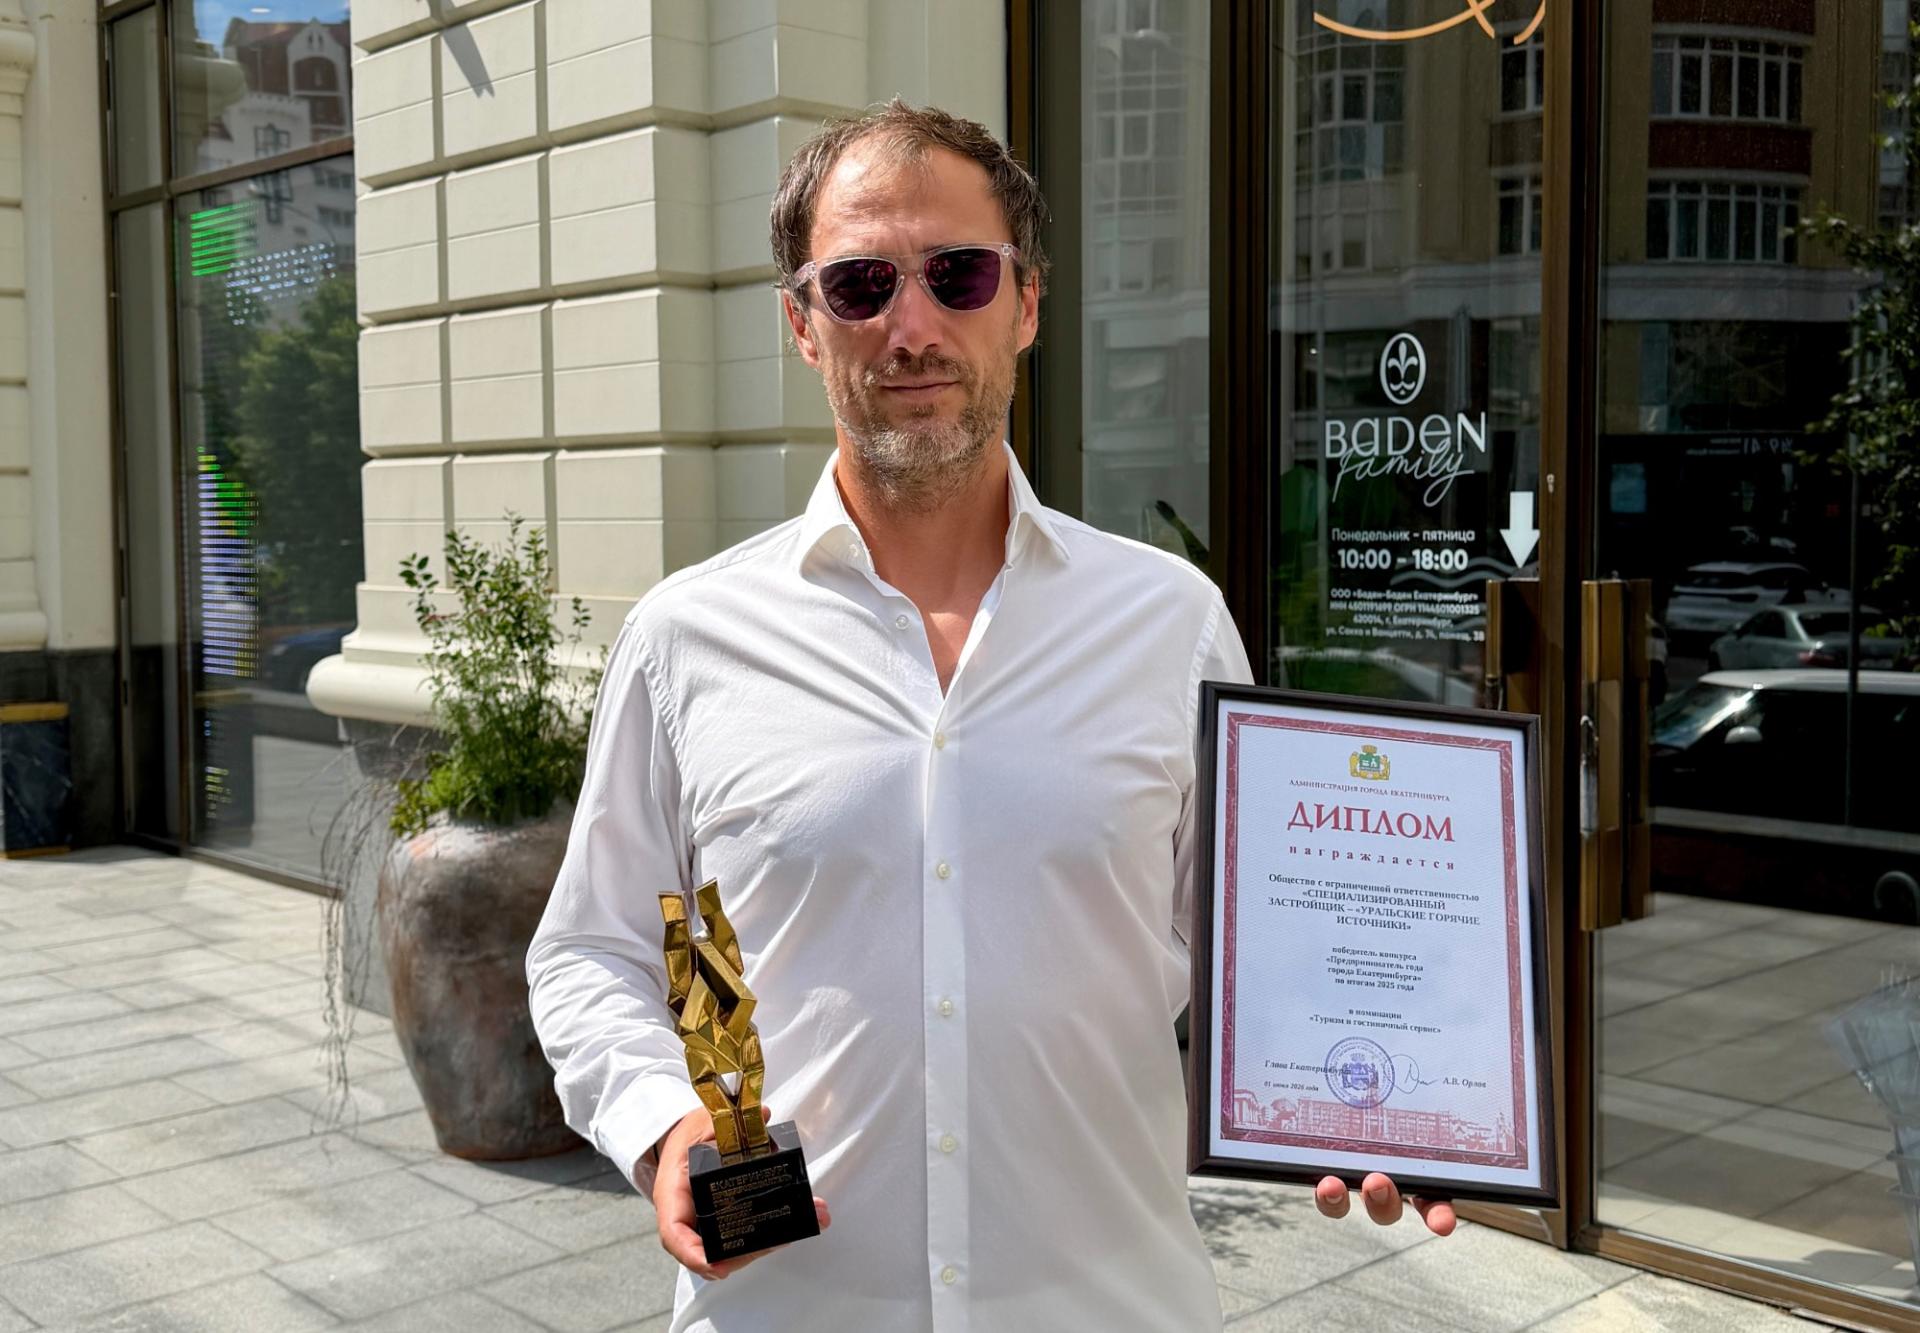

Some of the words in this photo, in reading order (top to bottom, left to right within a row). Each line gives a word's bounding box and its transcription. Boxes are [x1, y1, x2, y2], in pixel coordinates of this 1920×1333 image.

[1332, 528, 1410, 542] Понедельник
[1422, 529, 1475, 543] пятница
[1337, 549, 1391, 569] 10:00
[1412, 549, 1468, 570] 18:00
[1330, 588, 1351, 598] ООО
[1289, 779, 1358, 793] АДМИНИСТРАЦИЯ
[1360, 786, 1388, 796] ГОРОДА
[1390, 790, 1450, 802] ЕКАТЕРИНБУРГА
[1287, 800, 1455, 842] ДИПЛОМ
[1268, 873, 1315, 887] Общество
[1325, 880, 1391, 894] ограниченной
[1393, 888, 1479, 901] ответственностью
[1302, 889, 1445, 910] «СПЕЦИАЛИЗИРОВАННЫЙ
[1268, 897, 1345, 913] ЗАСТРОЙЩИК
[1355, 906, 1426, 921] «УРАЛЬСКИЕ
[1428, 912, 1480, 926] ГОРЯЧИЕ
[1336, 915, 1411, 931] ИСТОЧНИКИ»
[1332, 946, 1377, 958] победитель
[1379, 951, 1417, 962] конкурса
[1326, 955, 1403, 970] «Предприниматель
[1405, 963, 1423, 973] года
[1327, 967, 1354, 977] города
[1356, 968, 1422, 983] Екатеринбурга»
[1346, 979, 1375, 988] итогам
[1377, 980, 1395, 989] 2025
[1396, 983, 1414, 992] года
[1355, 1009, 1402, 1020] номинации
[1309, 1013, 1344, 1026] «Туризм
[1353, 1019, 1407, 1031] гостиничный
[1410, 1024, 1441, 1036] сервис»
[1264, 1060, 1288, 1070] Глава
[1462, 1078, 1487, 1089] Орлов
